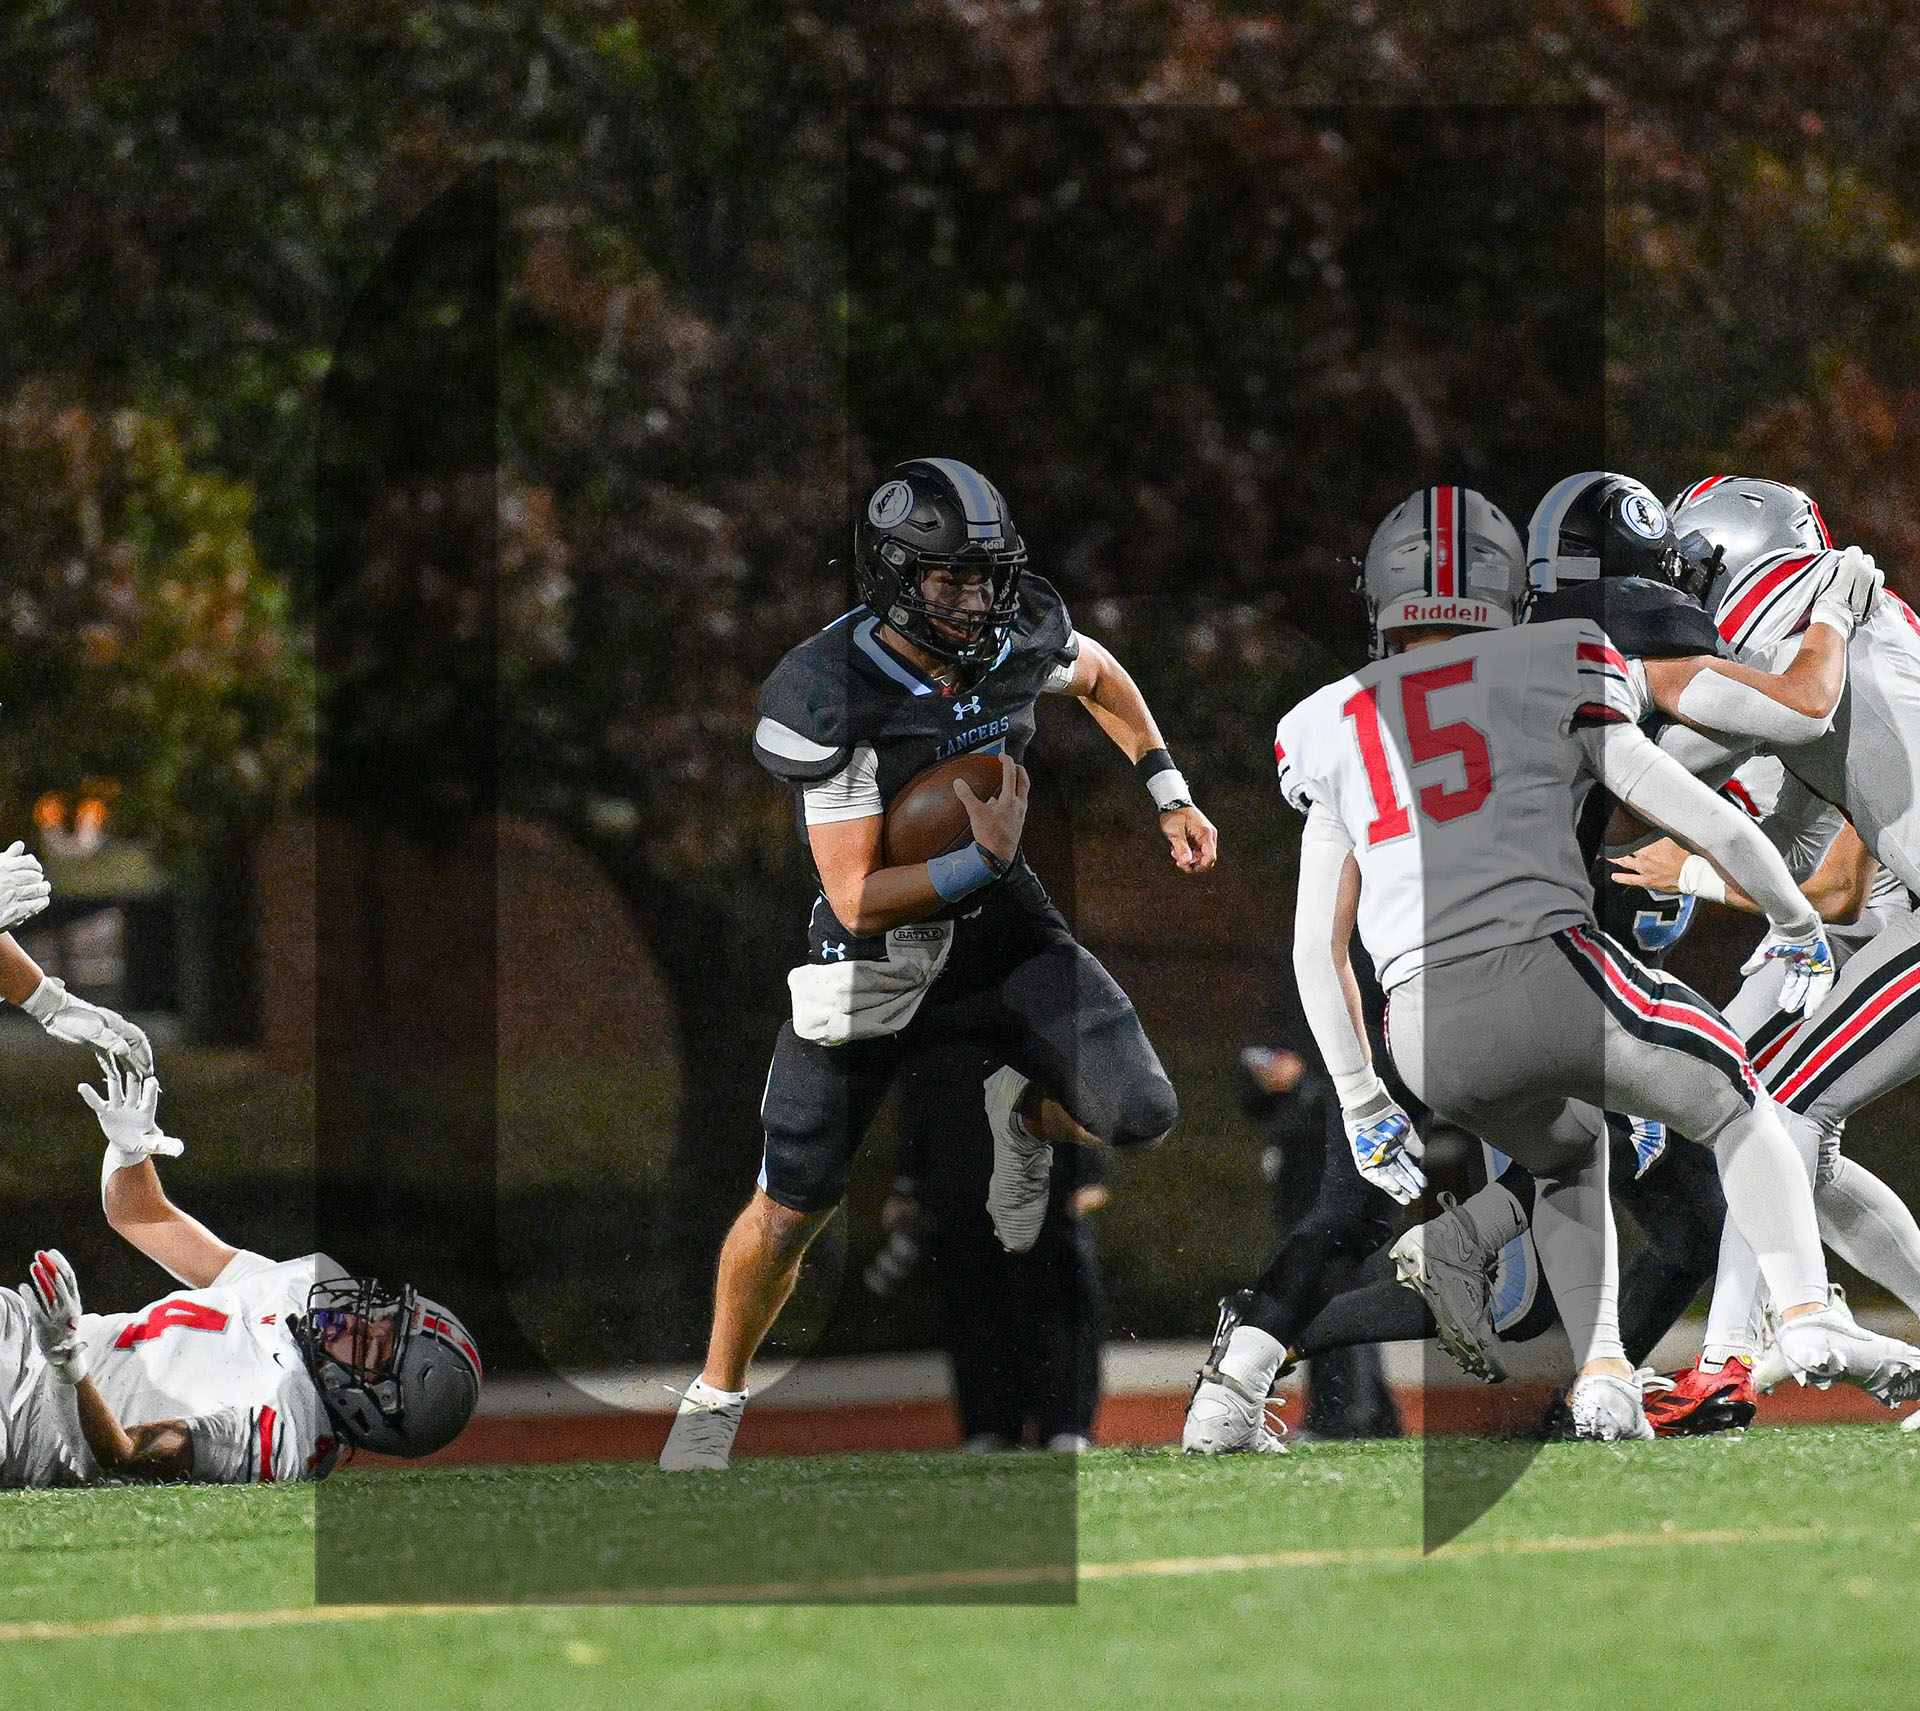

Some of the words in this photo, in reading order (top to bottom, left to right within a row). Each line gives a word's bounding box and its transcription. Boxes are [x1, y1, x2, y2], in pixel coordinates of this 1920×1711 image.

[1403, 603, 1488, 622] Riddell
[935, 715, 1009, 761] LANCERS
[1341, 656, 1495, 850] 15
